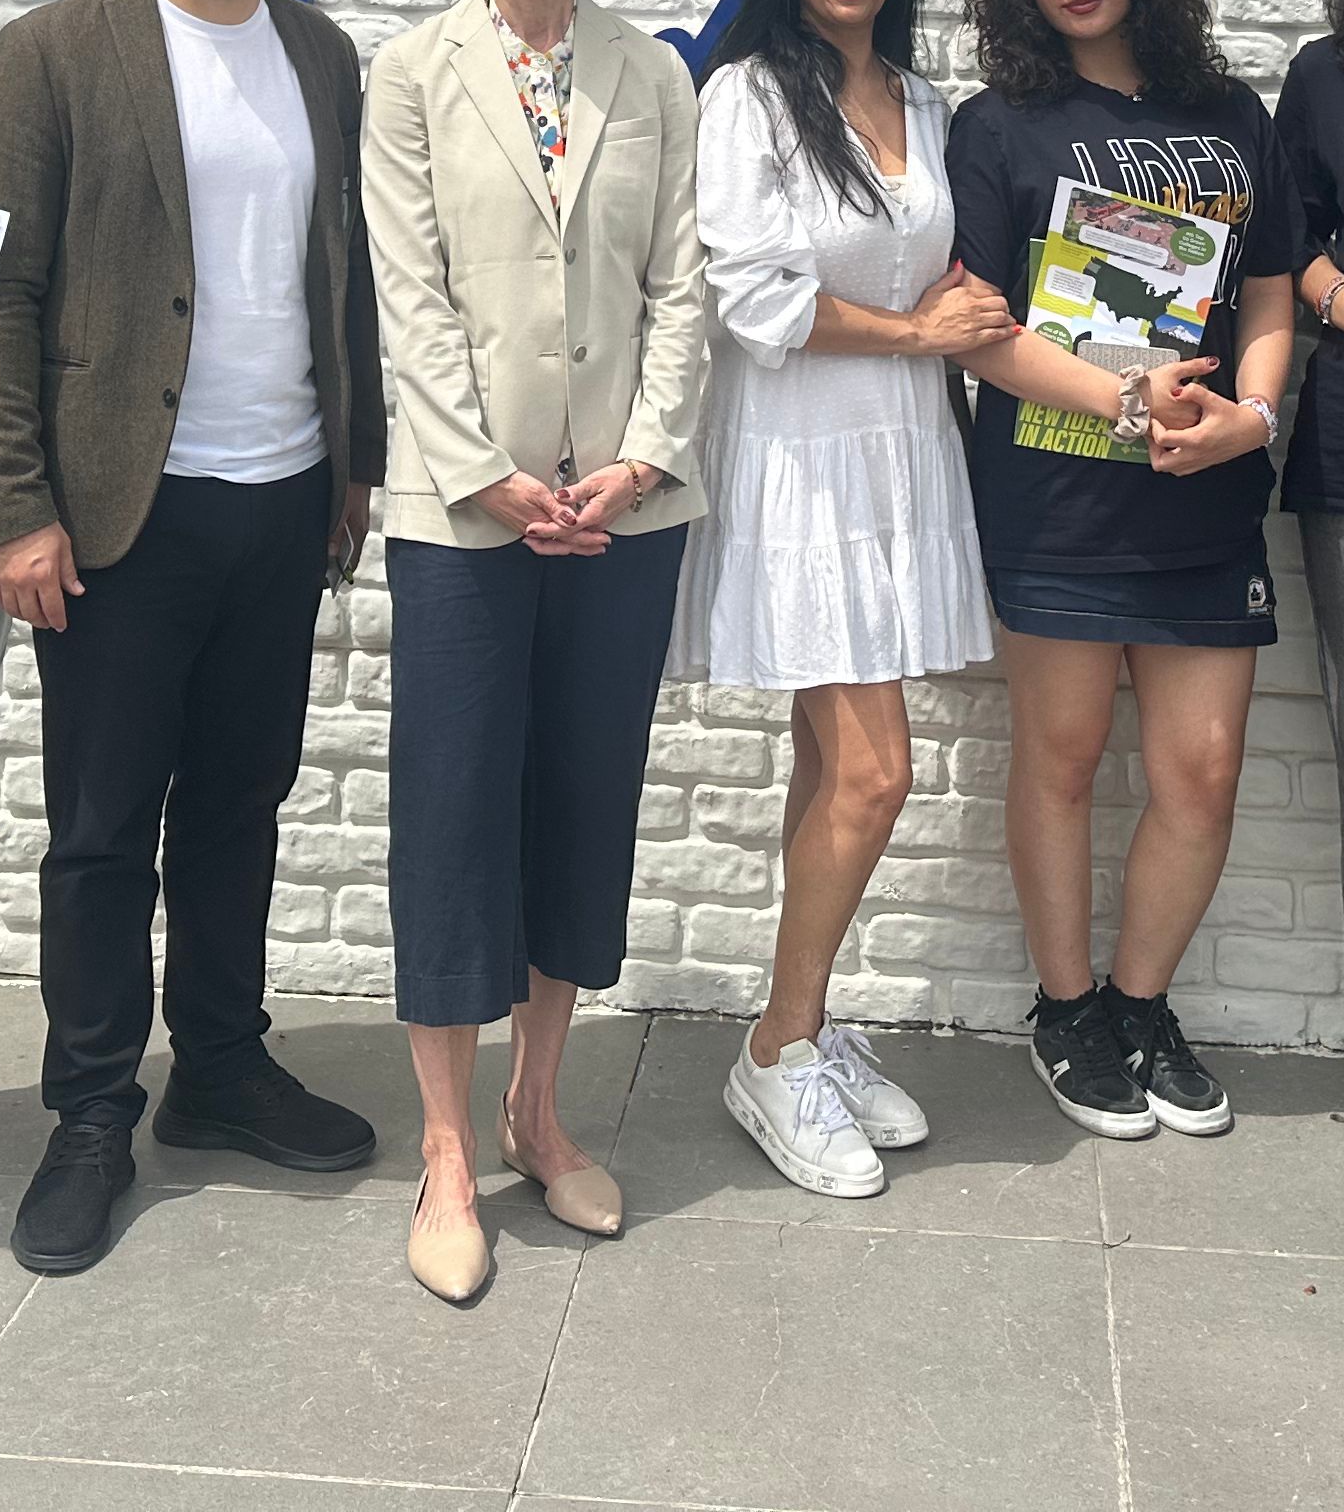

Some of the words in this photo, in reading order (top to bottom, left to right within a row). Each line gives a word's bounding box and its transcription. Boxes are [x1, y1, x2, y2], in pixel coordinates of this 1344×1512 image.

[1019, 399, 1061, 427] NEW
[1063, 410, 1110, 435] IDEA
[1016, 422, 1041, 448] IN
[1039, 428, 1112, 459] ACTION
